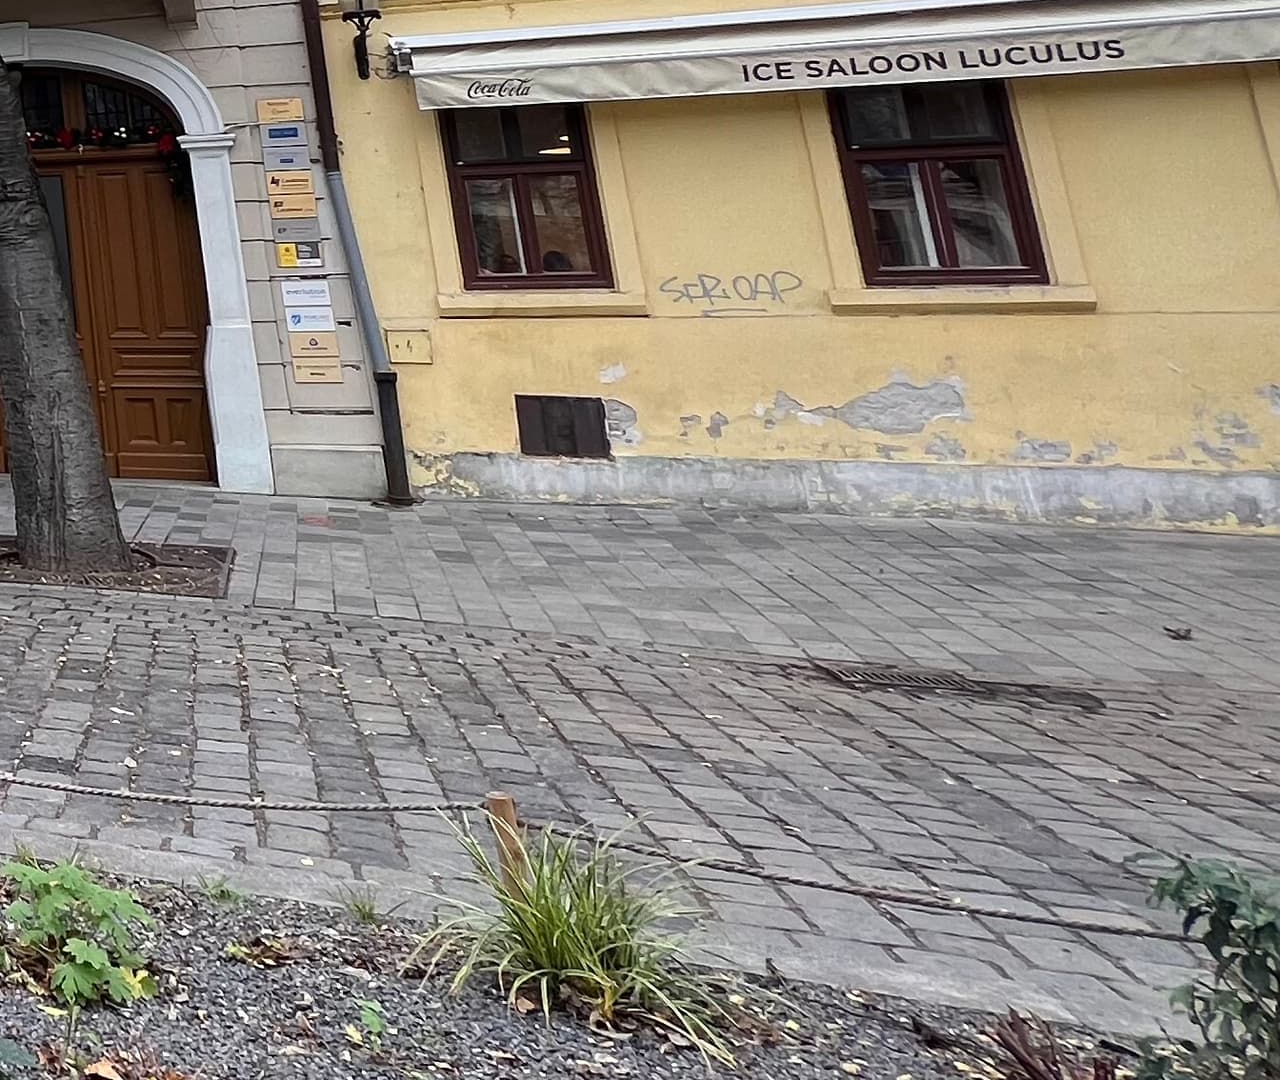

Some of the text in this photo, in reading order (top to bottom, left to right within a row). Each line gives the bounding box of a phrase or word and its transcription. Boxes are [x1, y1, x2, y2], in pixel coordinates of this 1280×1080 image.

[741, 39, 1126, 82] ICE SALOON LUCULUS
